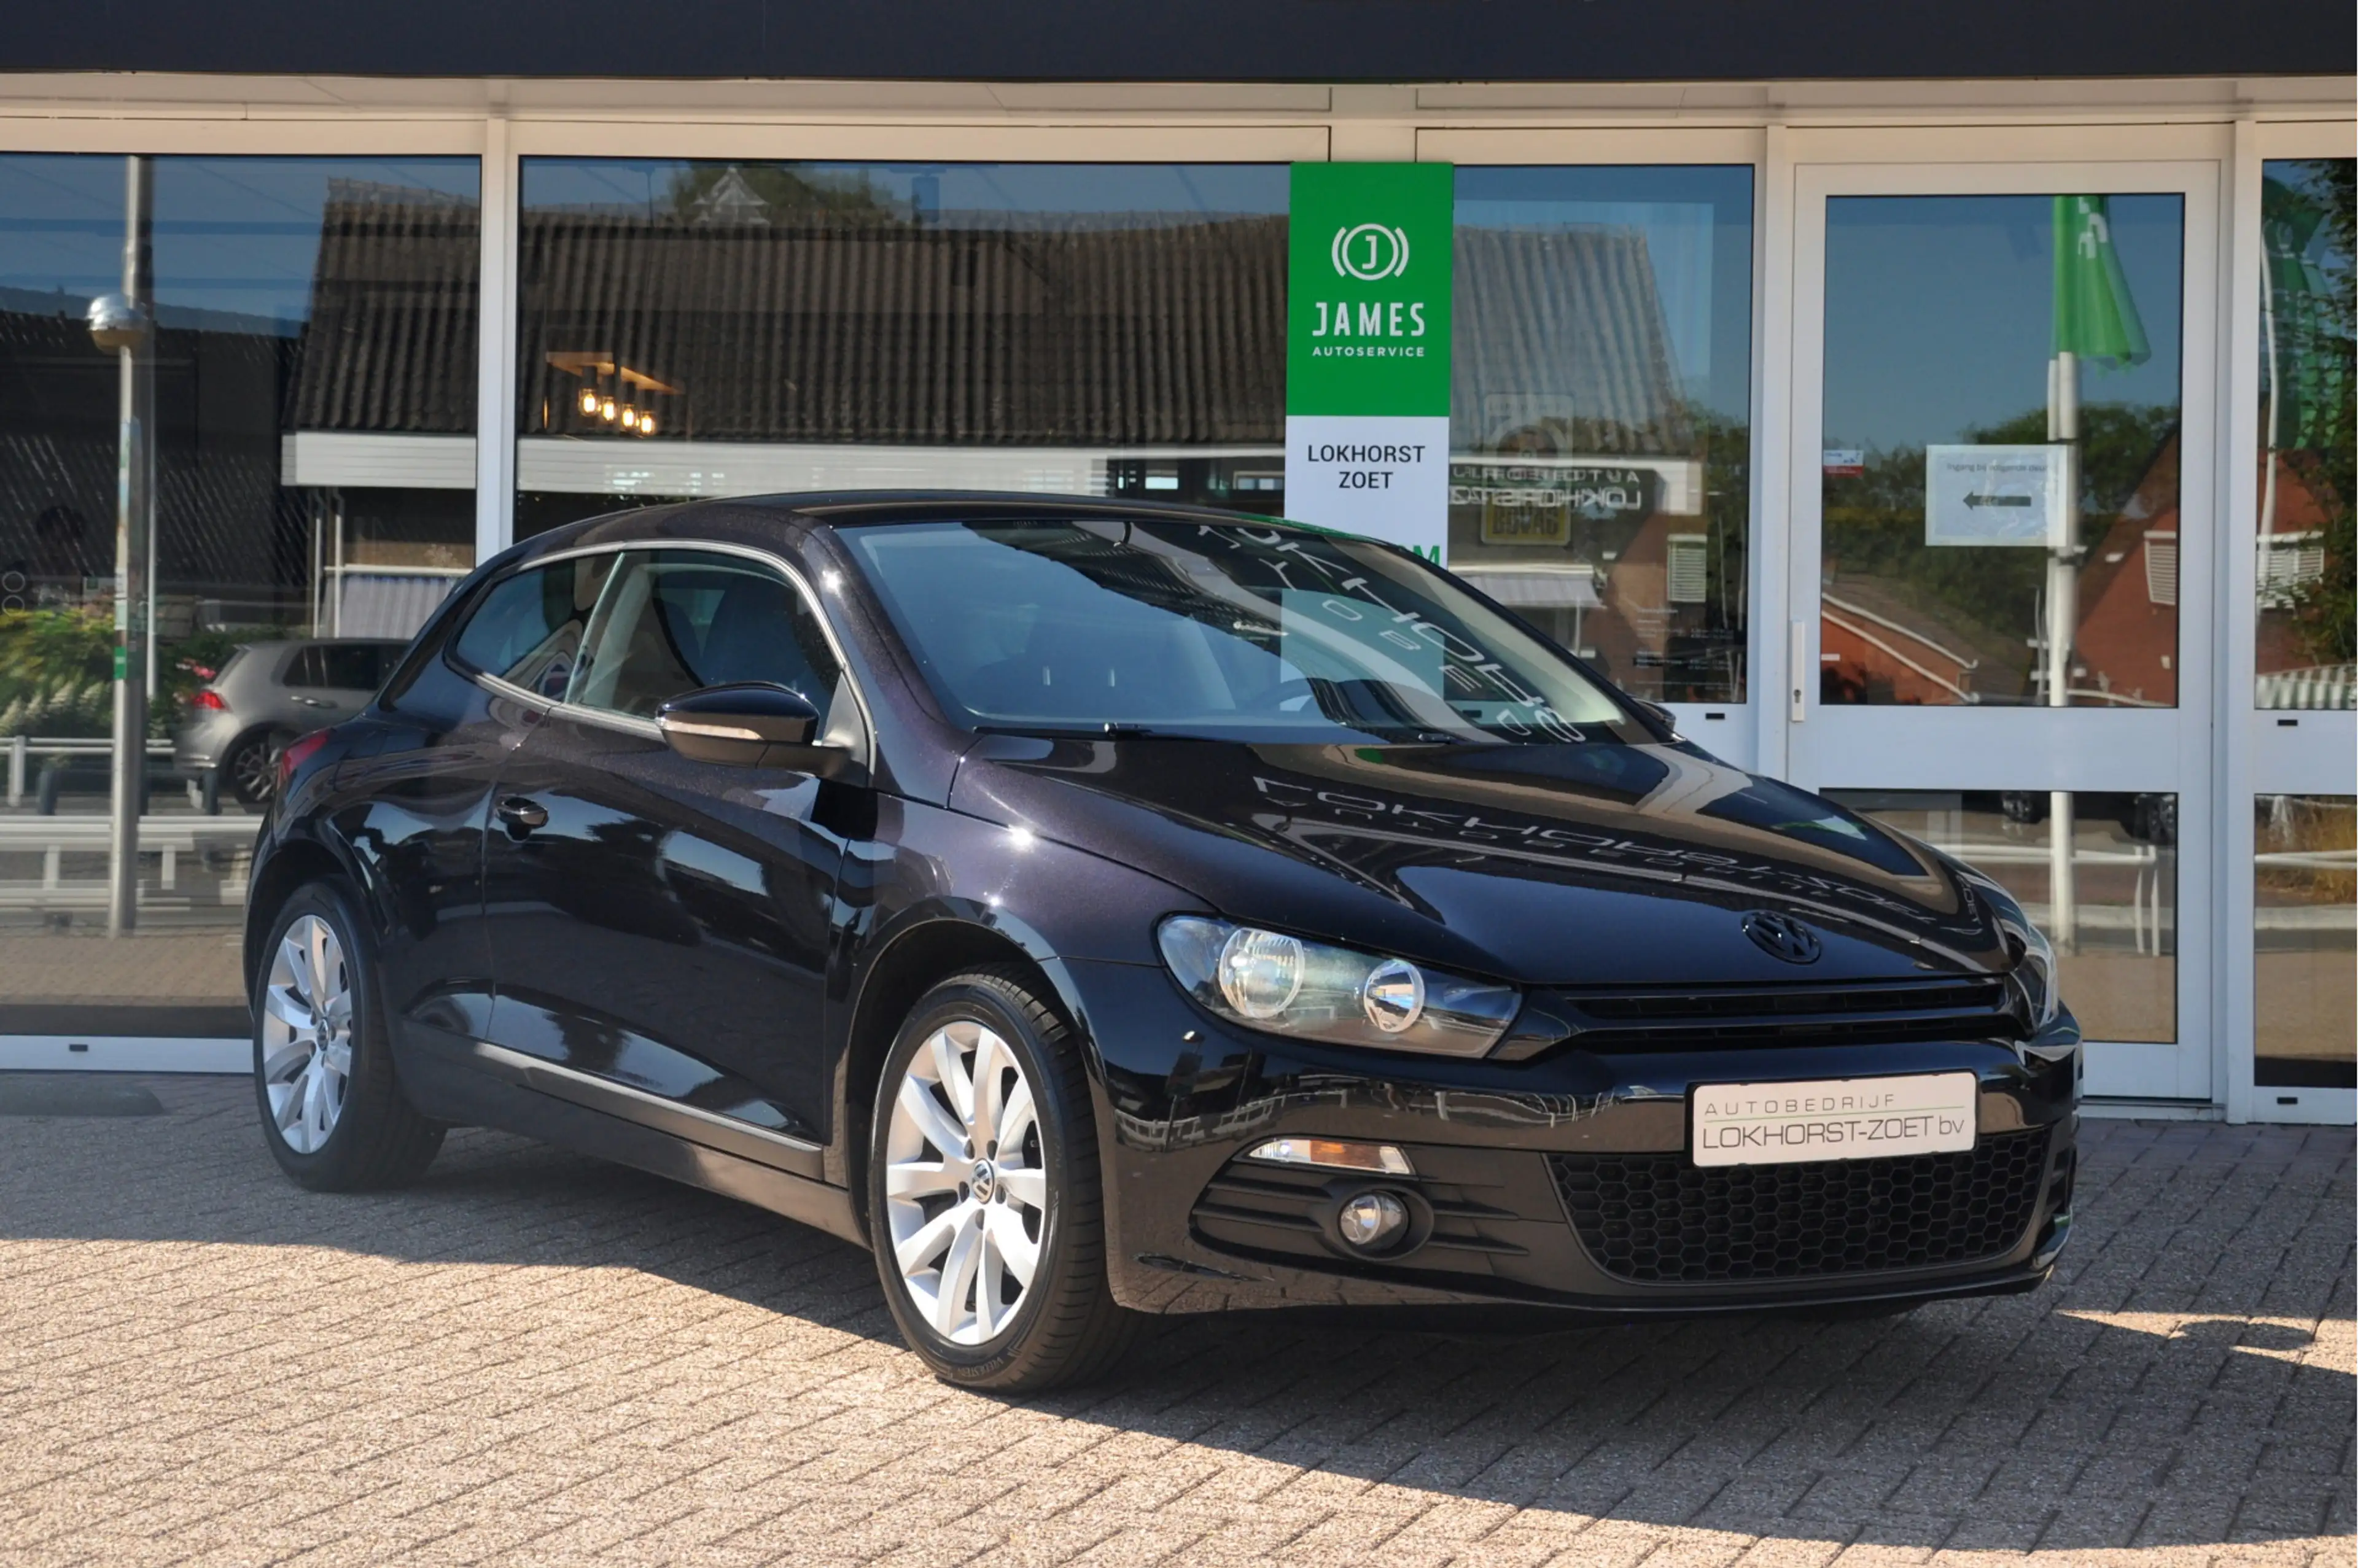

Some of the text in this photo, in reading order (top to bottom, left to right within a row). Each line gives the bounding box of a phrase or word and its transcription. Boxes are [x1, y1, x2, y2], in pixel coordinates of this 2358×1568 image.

[1312, 302, 1425, 336] JAMES
[1312, 346, 1425, 357] AUTOSERVICE
[1307, 444, 1426, 462] LOKHORST
[1339, 471, 1394, 489] ZOET
[1704, 1094, 1894, 1116] AUTOBEDRIJF
[1702, 1115, 1965, 1149] LOKHORST-ZOET bv
